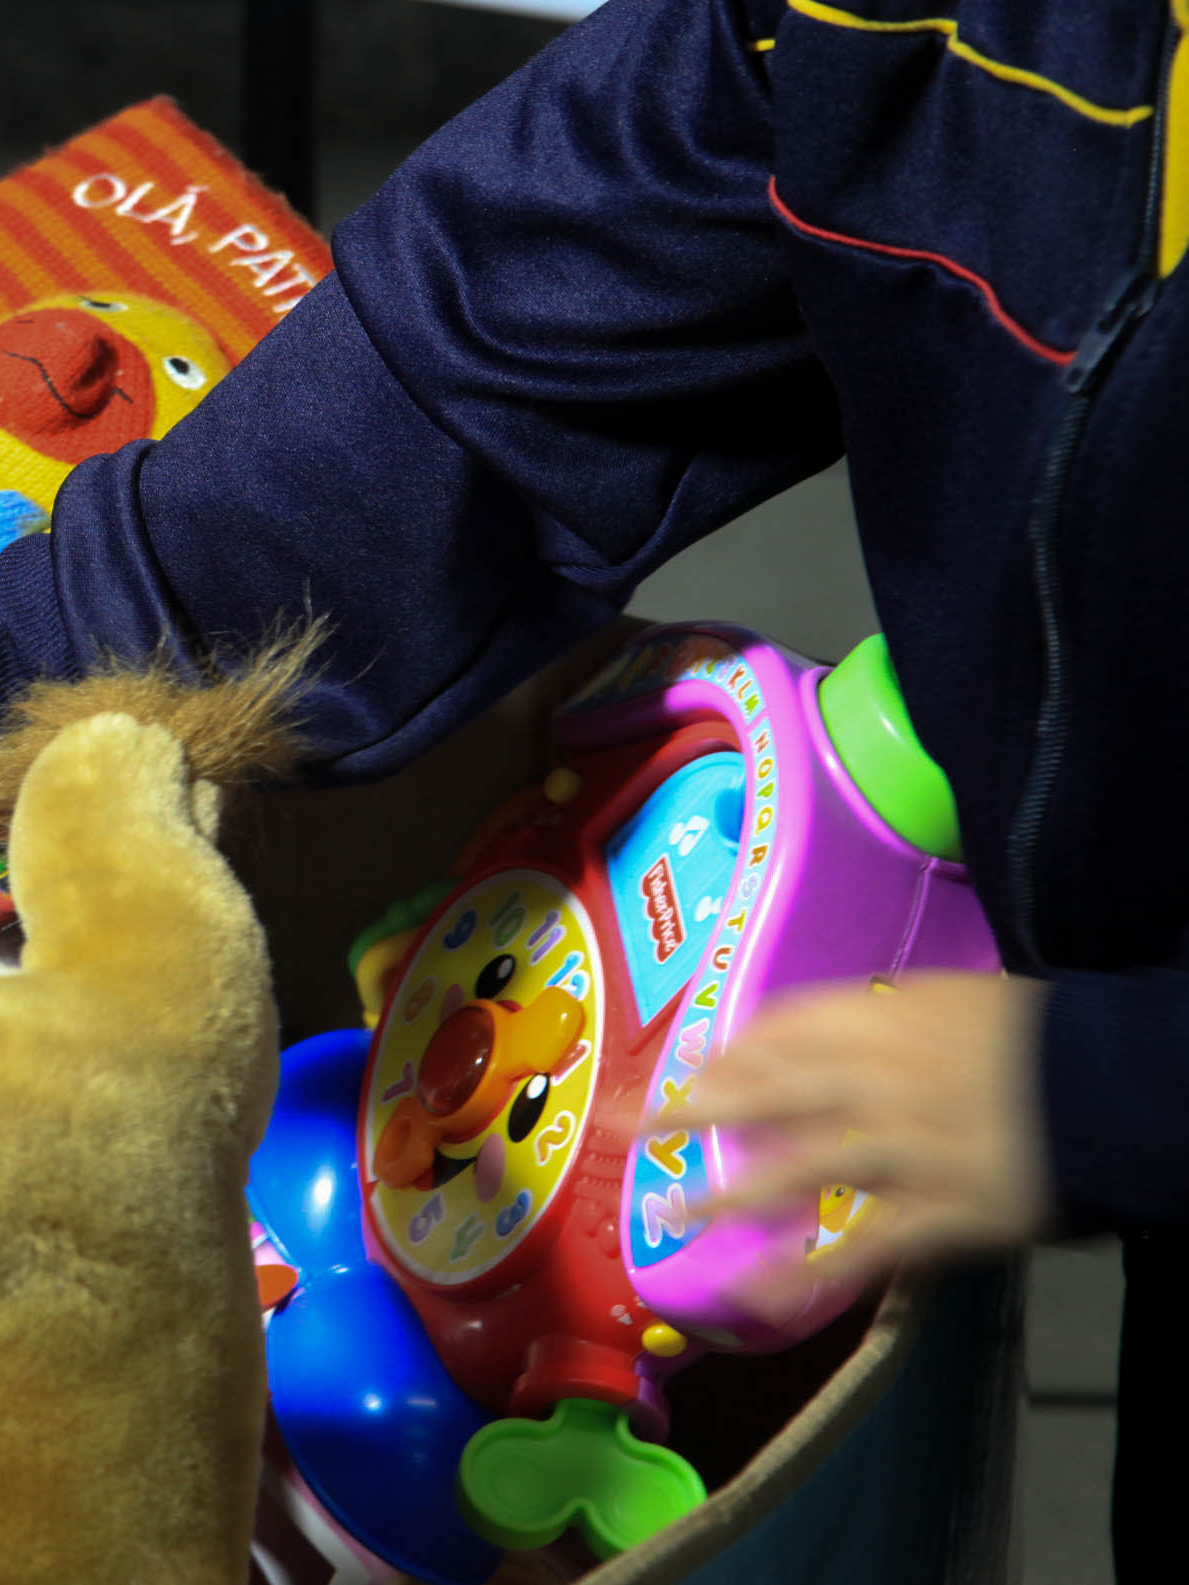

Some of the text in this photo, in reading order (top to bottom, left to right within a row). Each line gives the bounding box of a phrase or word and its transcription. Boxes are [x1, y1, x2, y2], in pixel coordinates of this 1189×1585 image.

[72, 172, 209, 246] OLÁ,
[748, 845, 768, 867] R
[442, 907, 478, 951] 9
[490, 895, 526, 948] 10
[526, 909, 566, 964] 11
[725, 908, 748, 934] T
[712, 945, 733, 971] U
[694, 983, 719, 1008] V
[534, 1110, 576, 1165] 2
[645, 1129, 689, 1179] Y
[642, 1182, 687, 1247] Z
